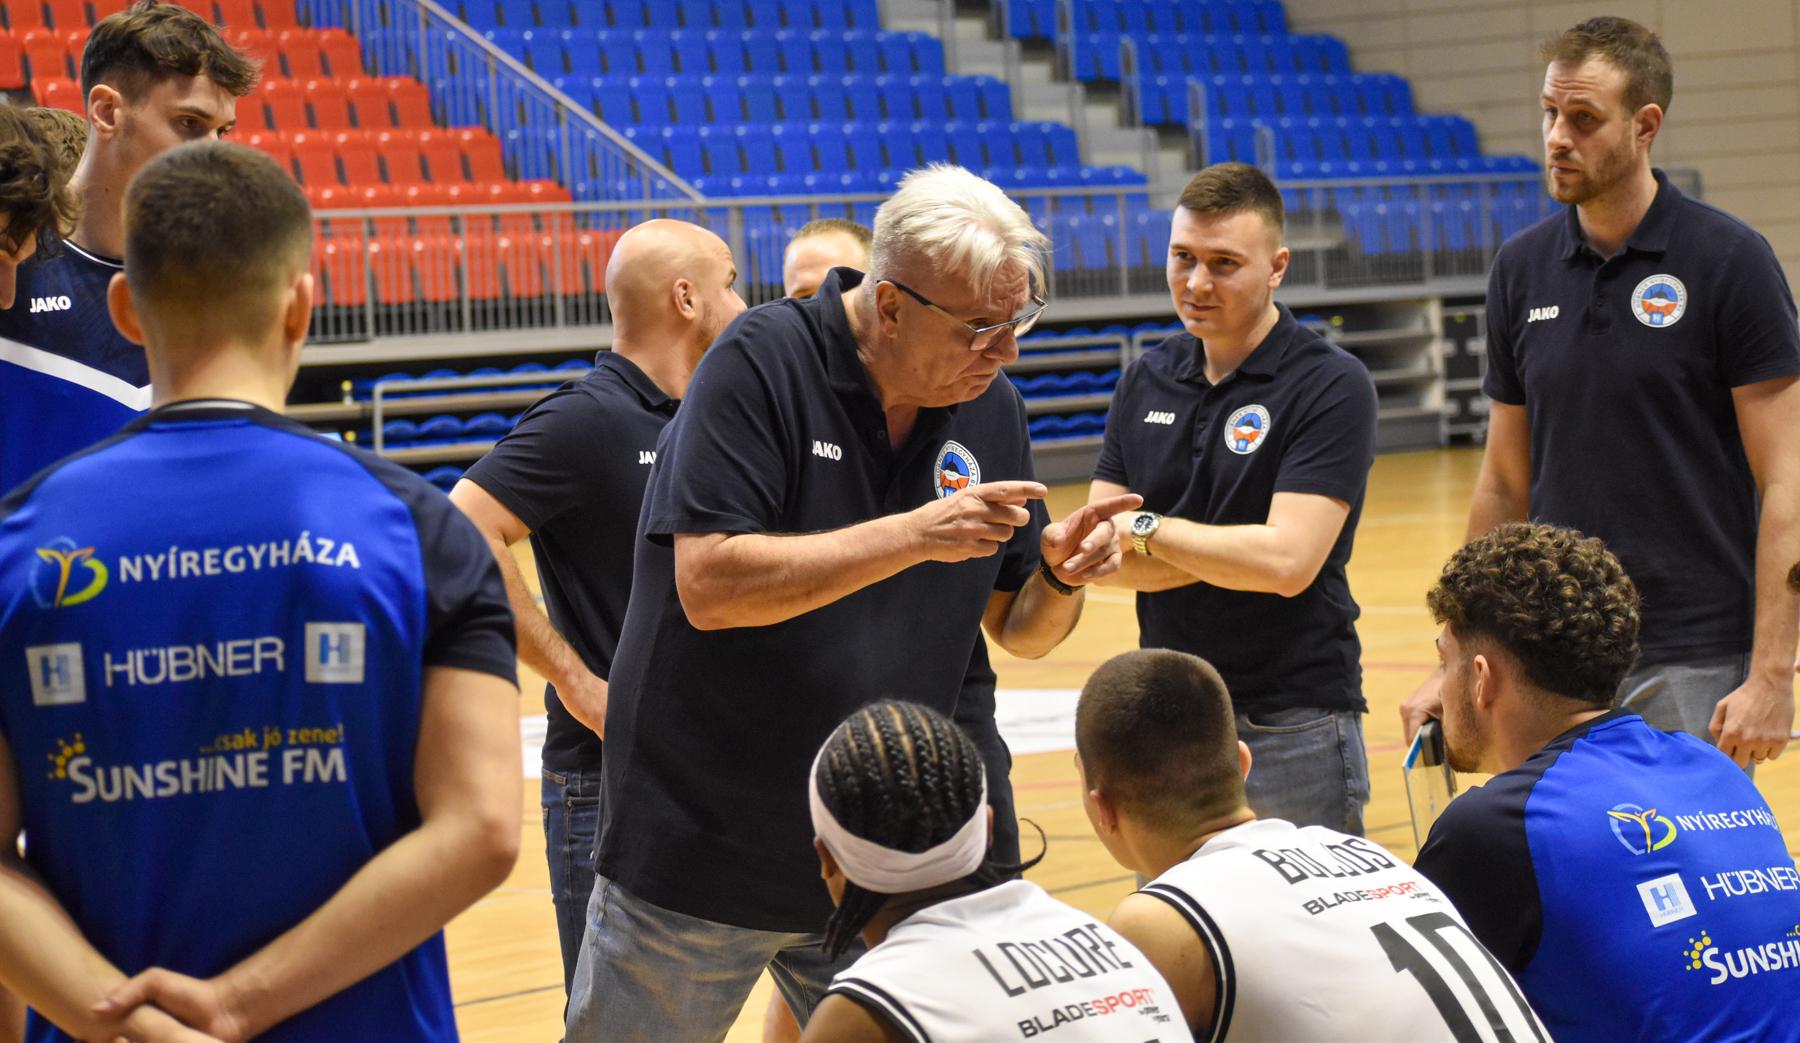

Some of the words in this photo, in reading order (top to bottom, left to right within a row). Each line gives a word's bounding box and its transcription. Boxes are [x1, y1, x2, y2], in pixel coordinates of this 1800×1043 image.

[30, 296, 71, 313] JAKO
[1528, 306, 1560, 322] JAKO
[1144, 411, 1175, 425] JAKO
[119, 531, 360, 583] NYÍREGYHÁZA
[104, 636, 285, 687] HÜBNER
[263, 725, 282, 751] jó
[288, 723, 344, 745] zene!
[67, 752, 269, 803] SUNSHINE
[283, 748, 347, 784] FM
[1302, 881, 1421, 915] BLADESPORT
[1700, 867, 1800, 900] HÜBNER
[972, 923, 1134, 998] LOCURE
[1017, 988, 1153, 1038] BLADESPORT
